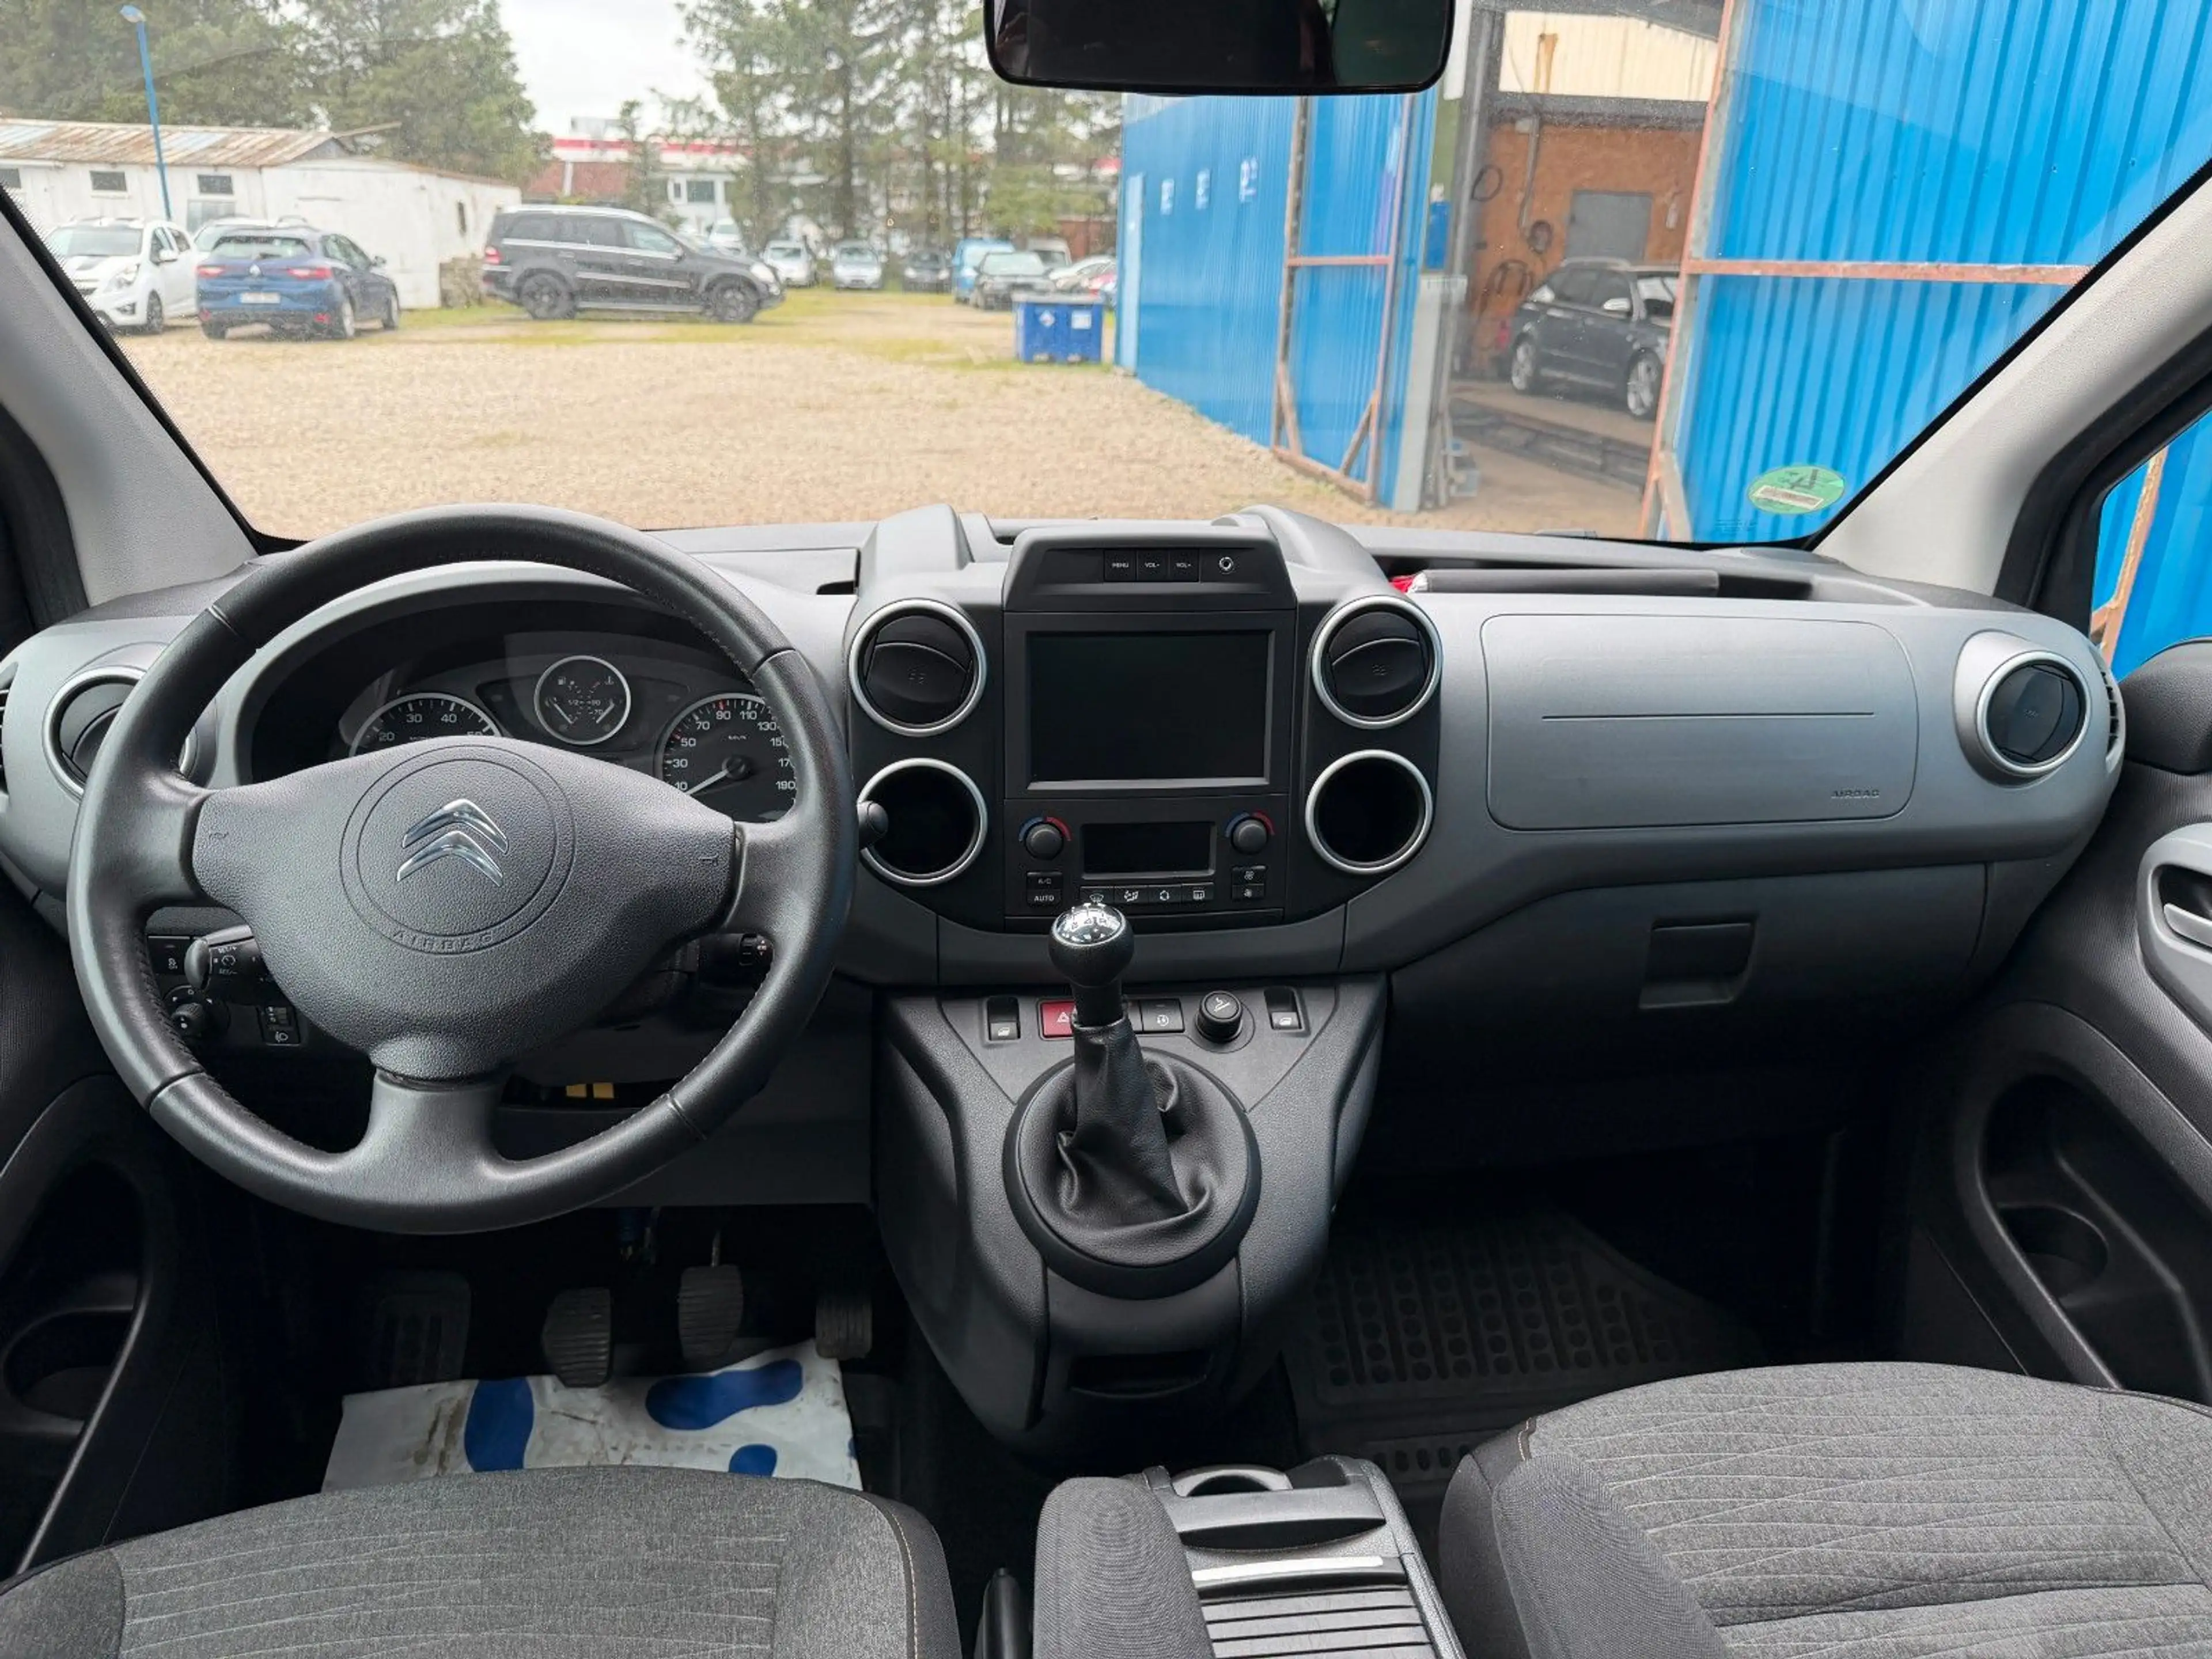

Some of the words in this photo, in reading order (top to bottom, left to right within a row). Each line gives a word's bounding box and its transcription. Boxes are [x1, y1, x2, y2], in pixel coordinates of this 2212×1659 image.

[406, 713, 422, 723] 30
[441, 713, 457, 723] 40
[716, 711, 731, 720] 90
[740, 711, 757, 720] 110
[696, 721, 710, 730] 70
[757, 721, 777, 730] 130
[378, 732, 395, 741] 20
[680, 738, 696, 747] 50
[673, 759, 688, 768] 30
[778, 759, 790, 767] 17
[675, 782, 688, 790] 10
[775, 781, 796, 790] 190
[1831, 789, 1880, 799] AIRBAG
